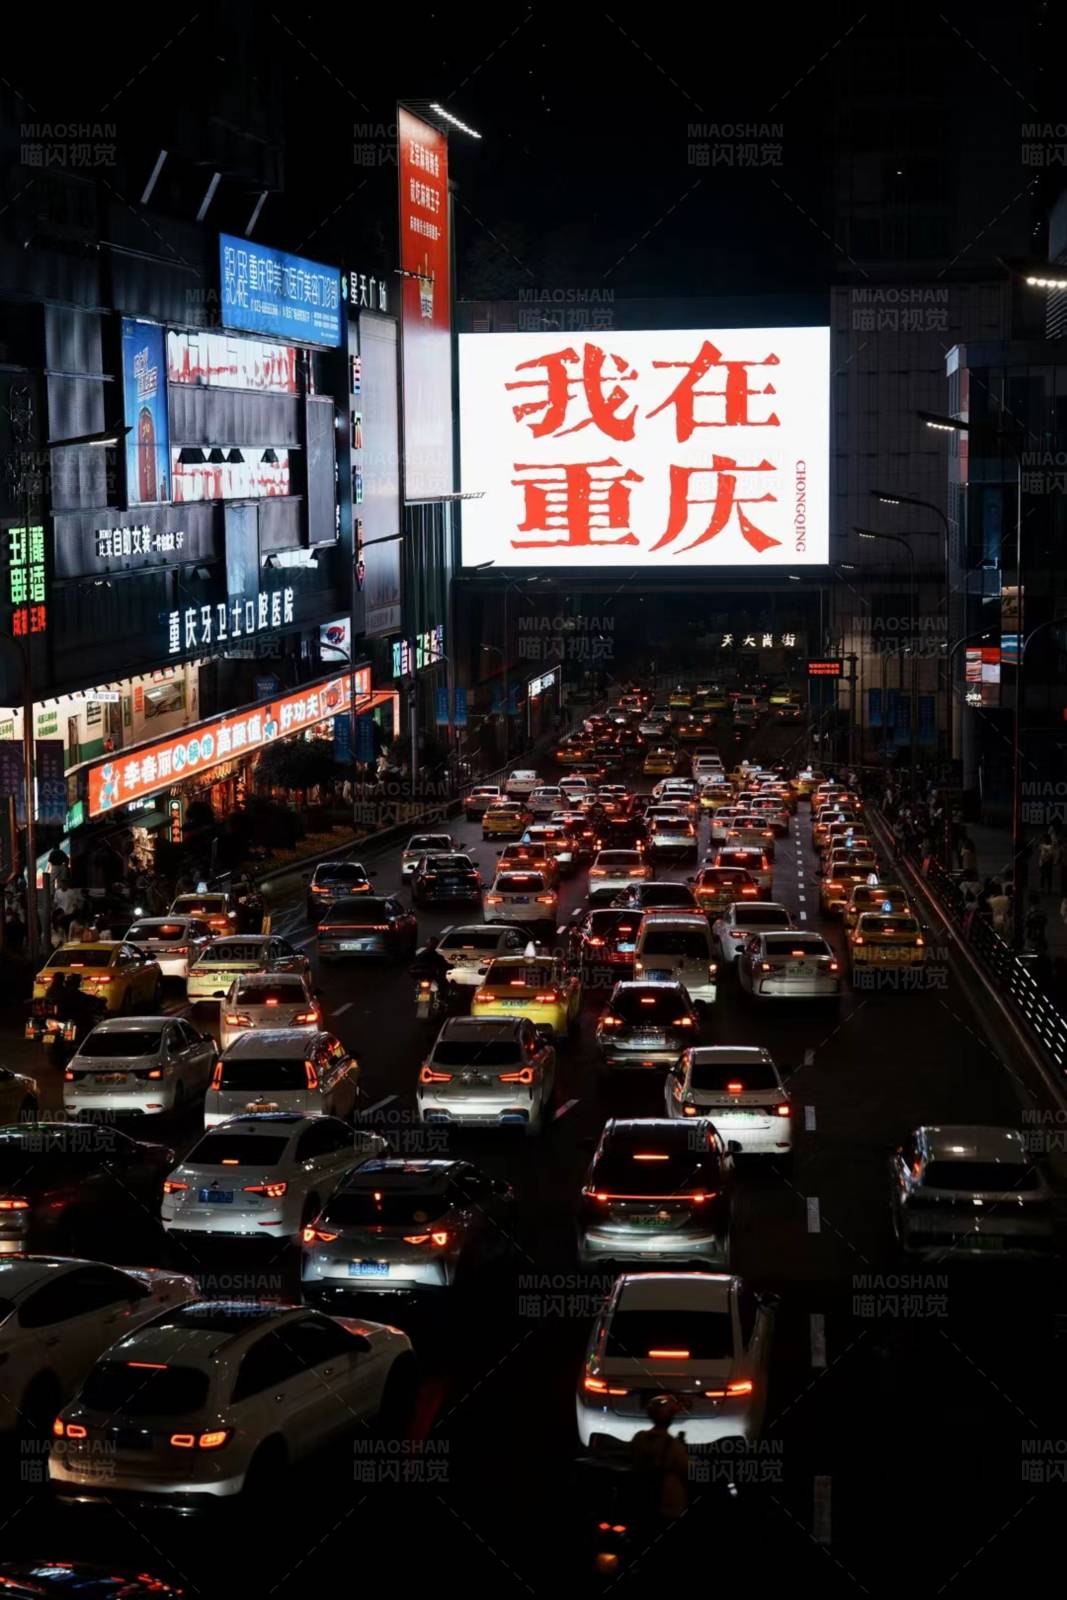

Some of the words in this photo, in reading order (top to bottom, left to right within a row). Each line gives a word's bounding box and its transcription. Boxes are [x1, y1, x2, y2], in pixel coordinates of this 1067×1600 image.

[504, 340, 781, 443] 我在
[509, 454, 782, 555] 重庆
[795, 459, 806, 553] CHONGQING
[168, 586, 294, 654] 重庆牙卫士口腔医院
[216, 713, 262, 758] 高颜值
[279, 693, 320, 731] 好功夫
